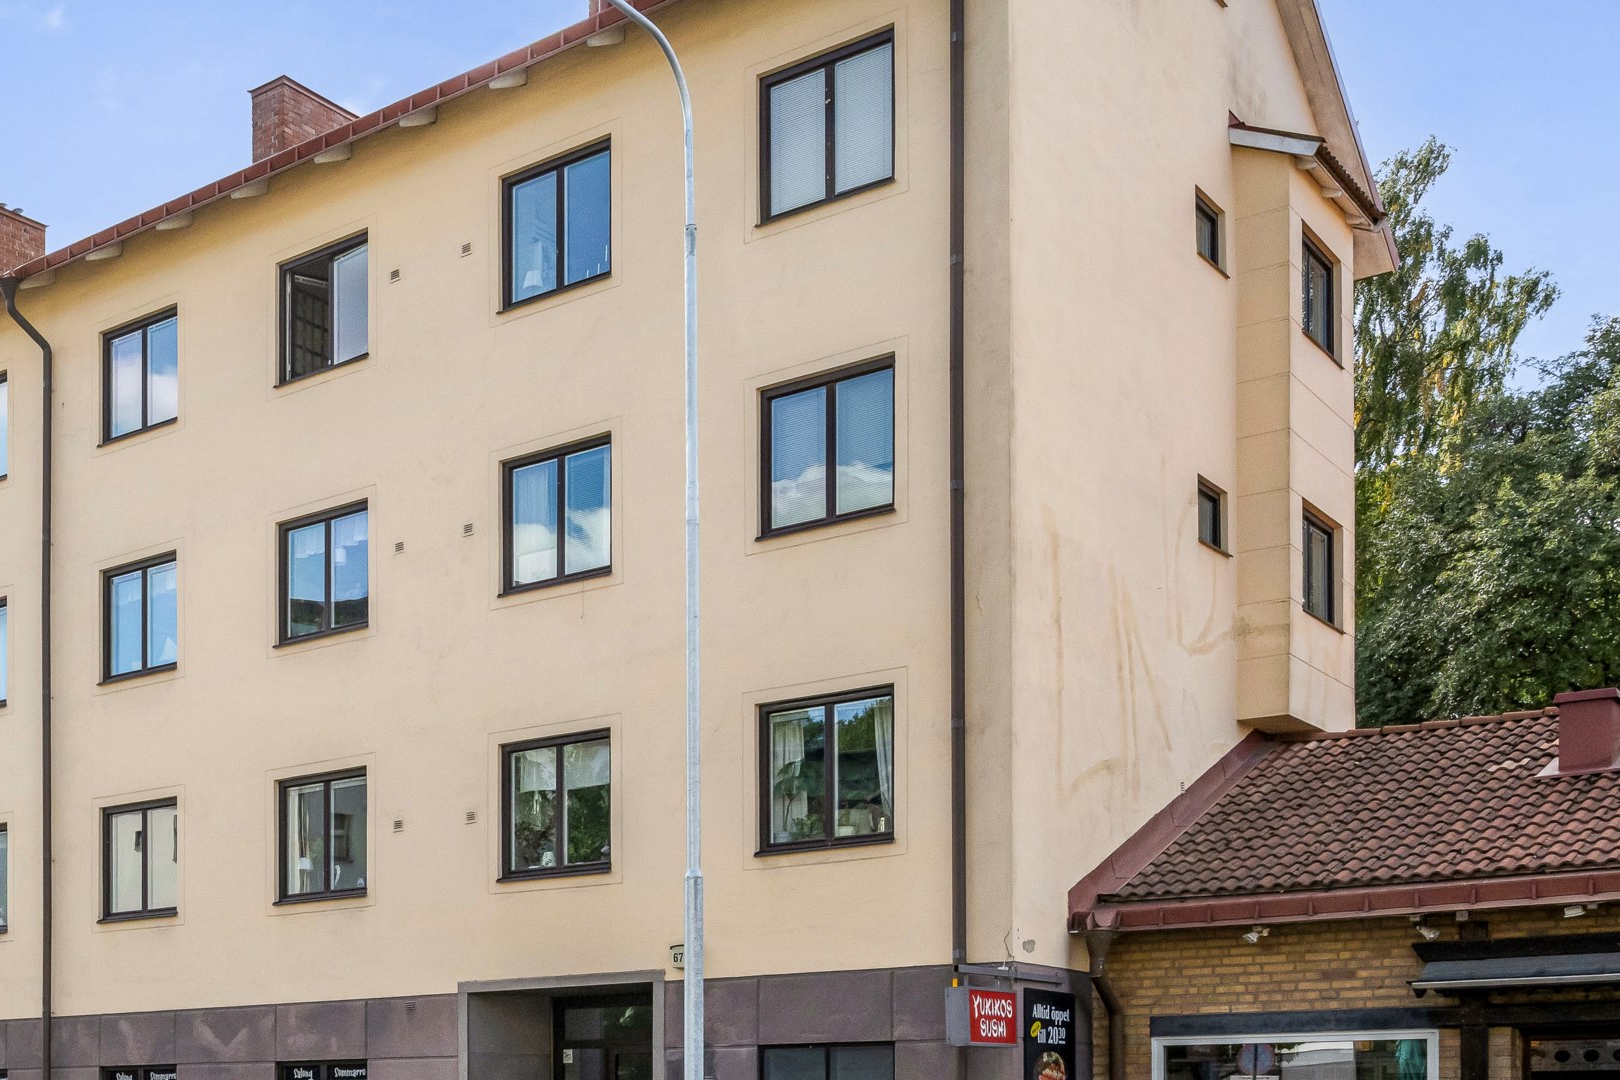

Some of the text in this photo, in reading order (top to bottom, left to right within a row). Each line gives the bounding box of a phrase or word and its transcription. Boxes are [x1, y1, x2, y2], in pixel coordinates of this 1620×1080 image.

[972, 994, 1013, 1019] YUKIKOS
[1032, 1003, 1070, 1026] Alltid öppet
[980, 1018, 1007, 1038] SUSHI
[334, 1067, 367, 1078] Sommarro
